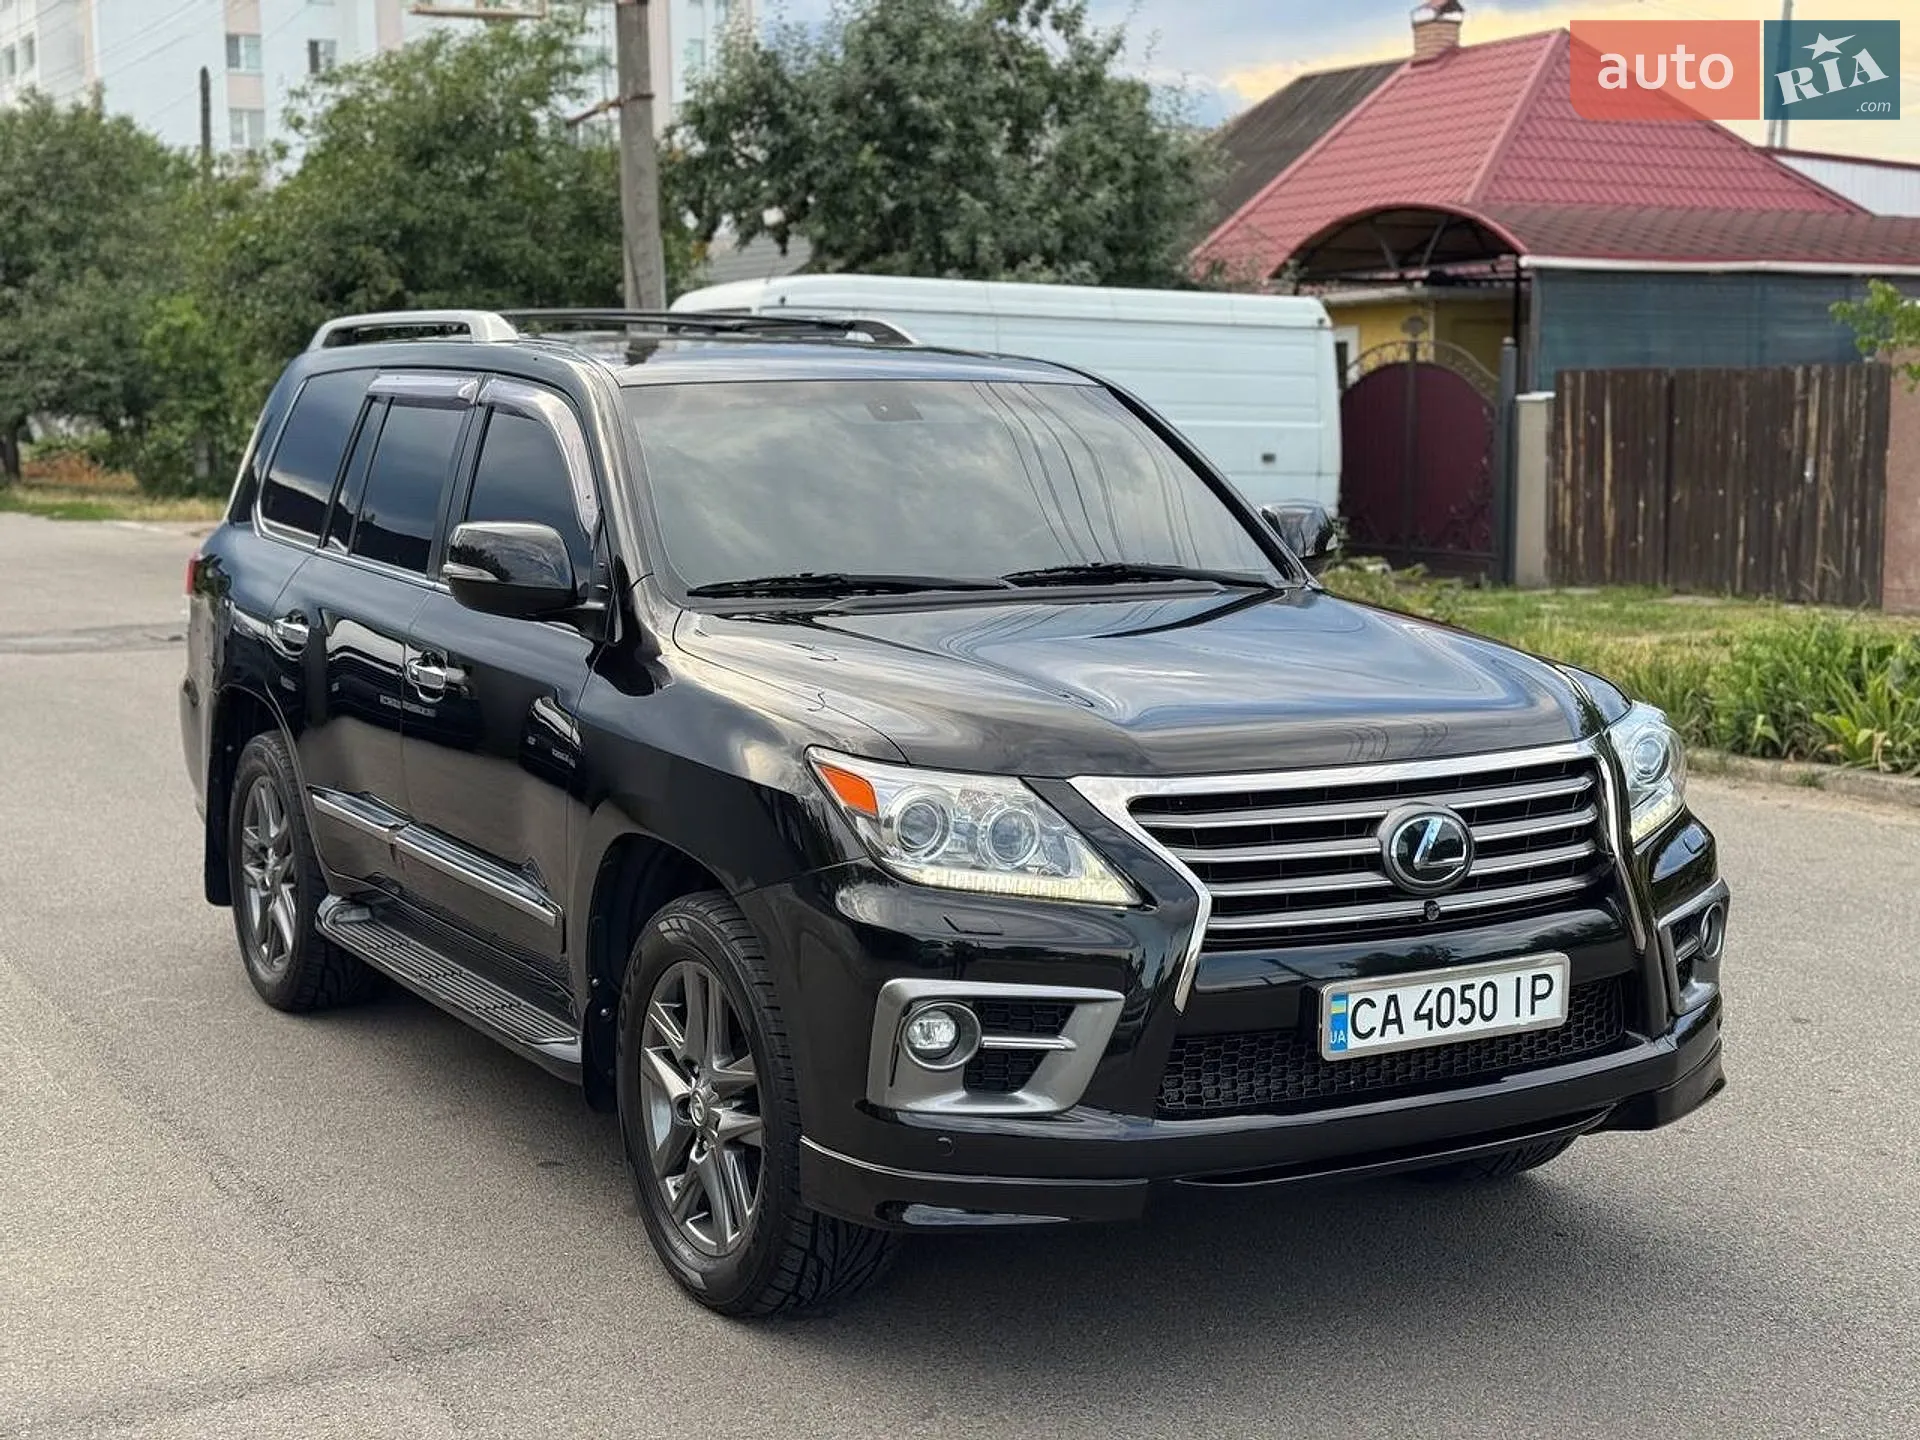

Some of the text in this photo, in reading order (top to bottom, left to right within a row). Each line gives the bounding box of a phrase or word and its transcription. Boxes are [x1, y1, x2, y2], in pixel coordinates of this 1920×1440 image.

[1350, 973, 1554, 1040] CA 4050 IP
[1330, 1030, 1346, 1044] UA
